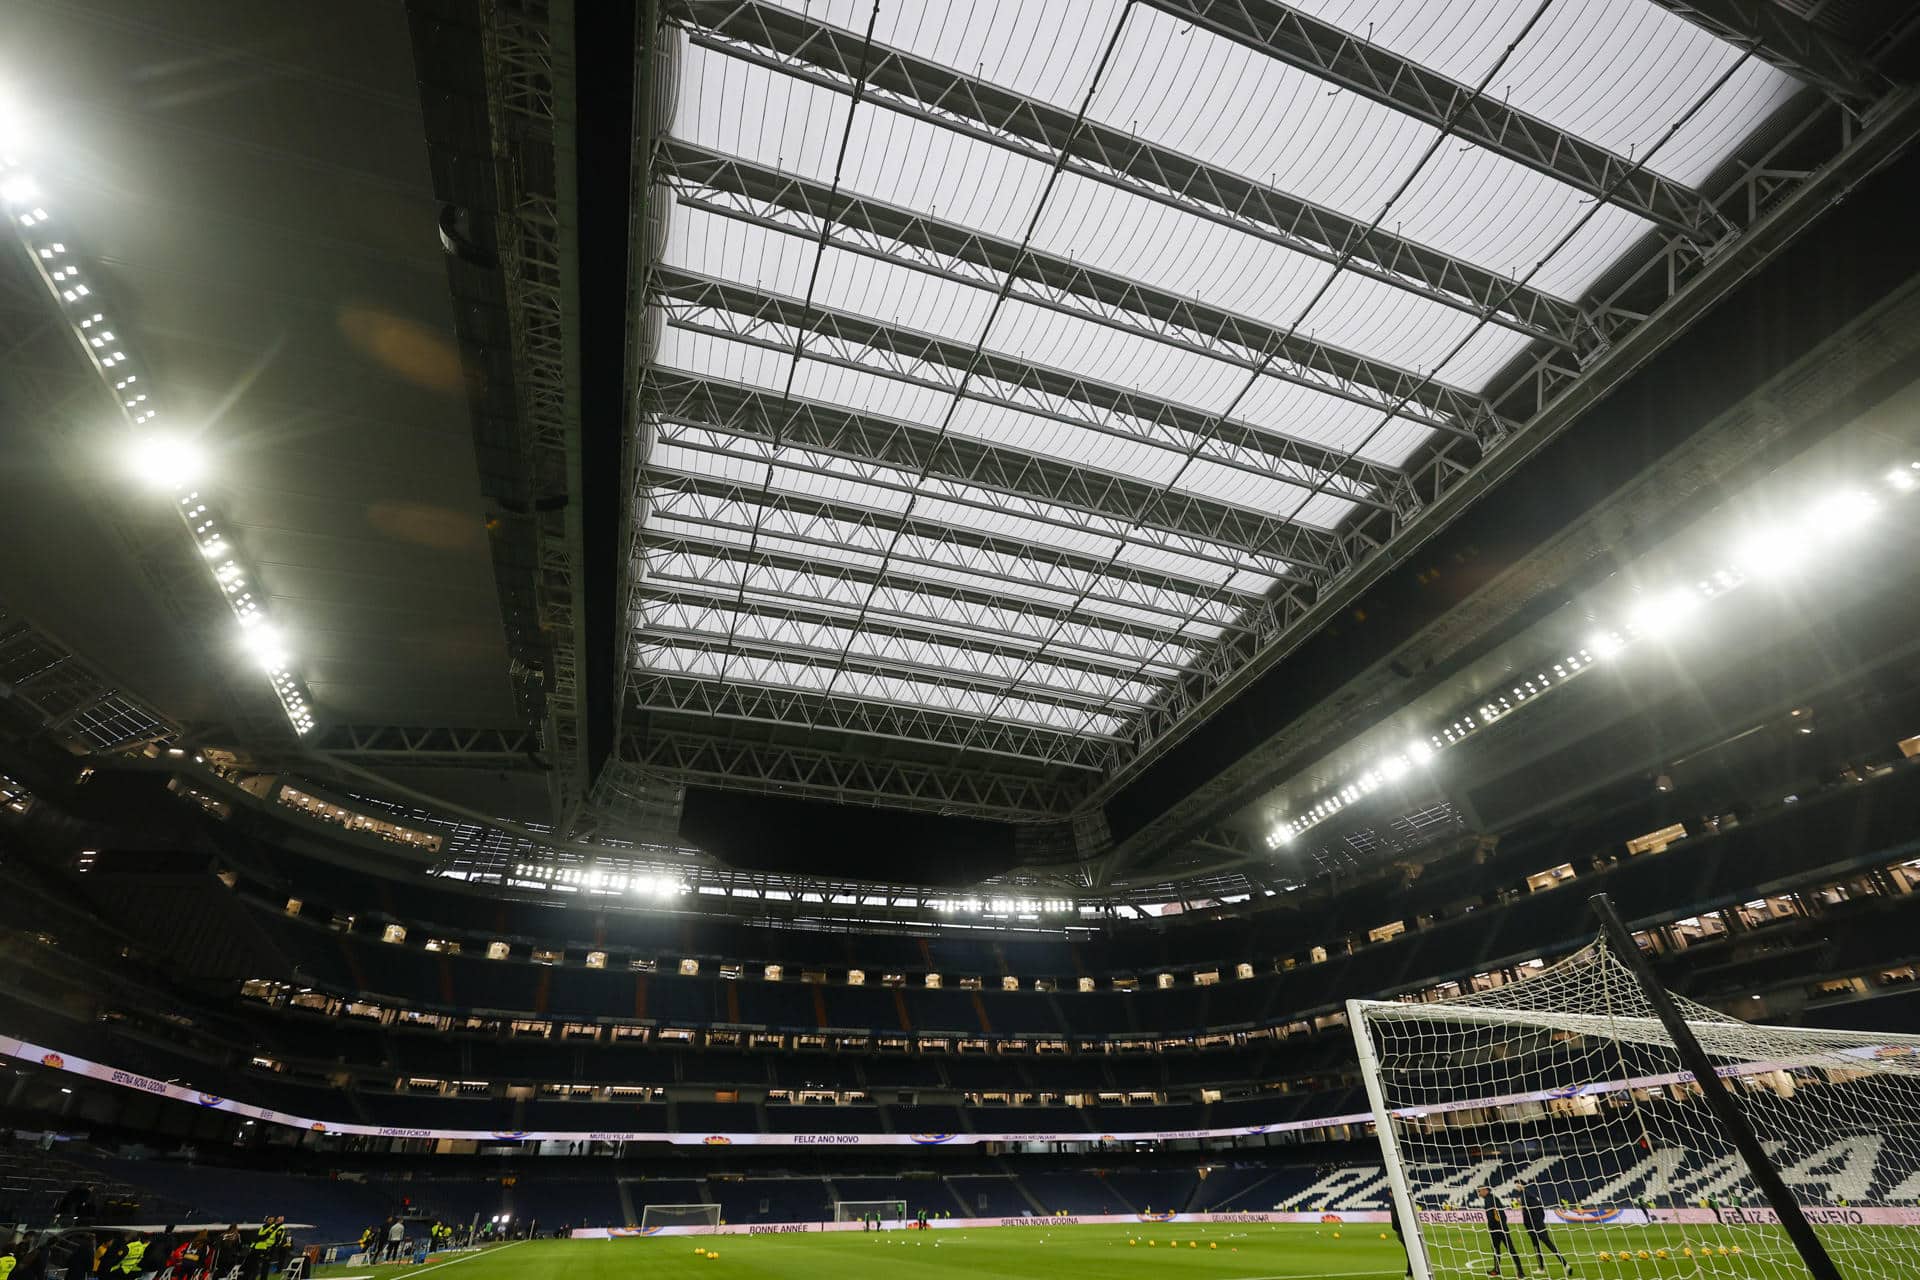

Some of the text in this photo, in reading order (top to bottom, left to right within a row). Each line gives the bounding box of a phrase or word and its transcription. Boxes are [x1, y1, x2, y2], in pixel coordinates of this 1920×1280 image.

[134, 1077, 148, 1089] NOVA
[794, 1135, 859, 1144] FELIZ ANO NOVO
[1001, 1216, 1079, 1227] SRETNA NOVA GODINA
[1462, 1212, 1484, 1222] JAHR
[1724, 1210, 1765, 1225] FELIZ
[1805, 1210, 1863, 1225] NUEVO
[750, 1225, 779, 1234] BONNE
